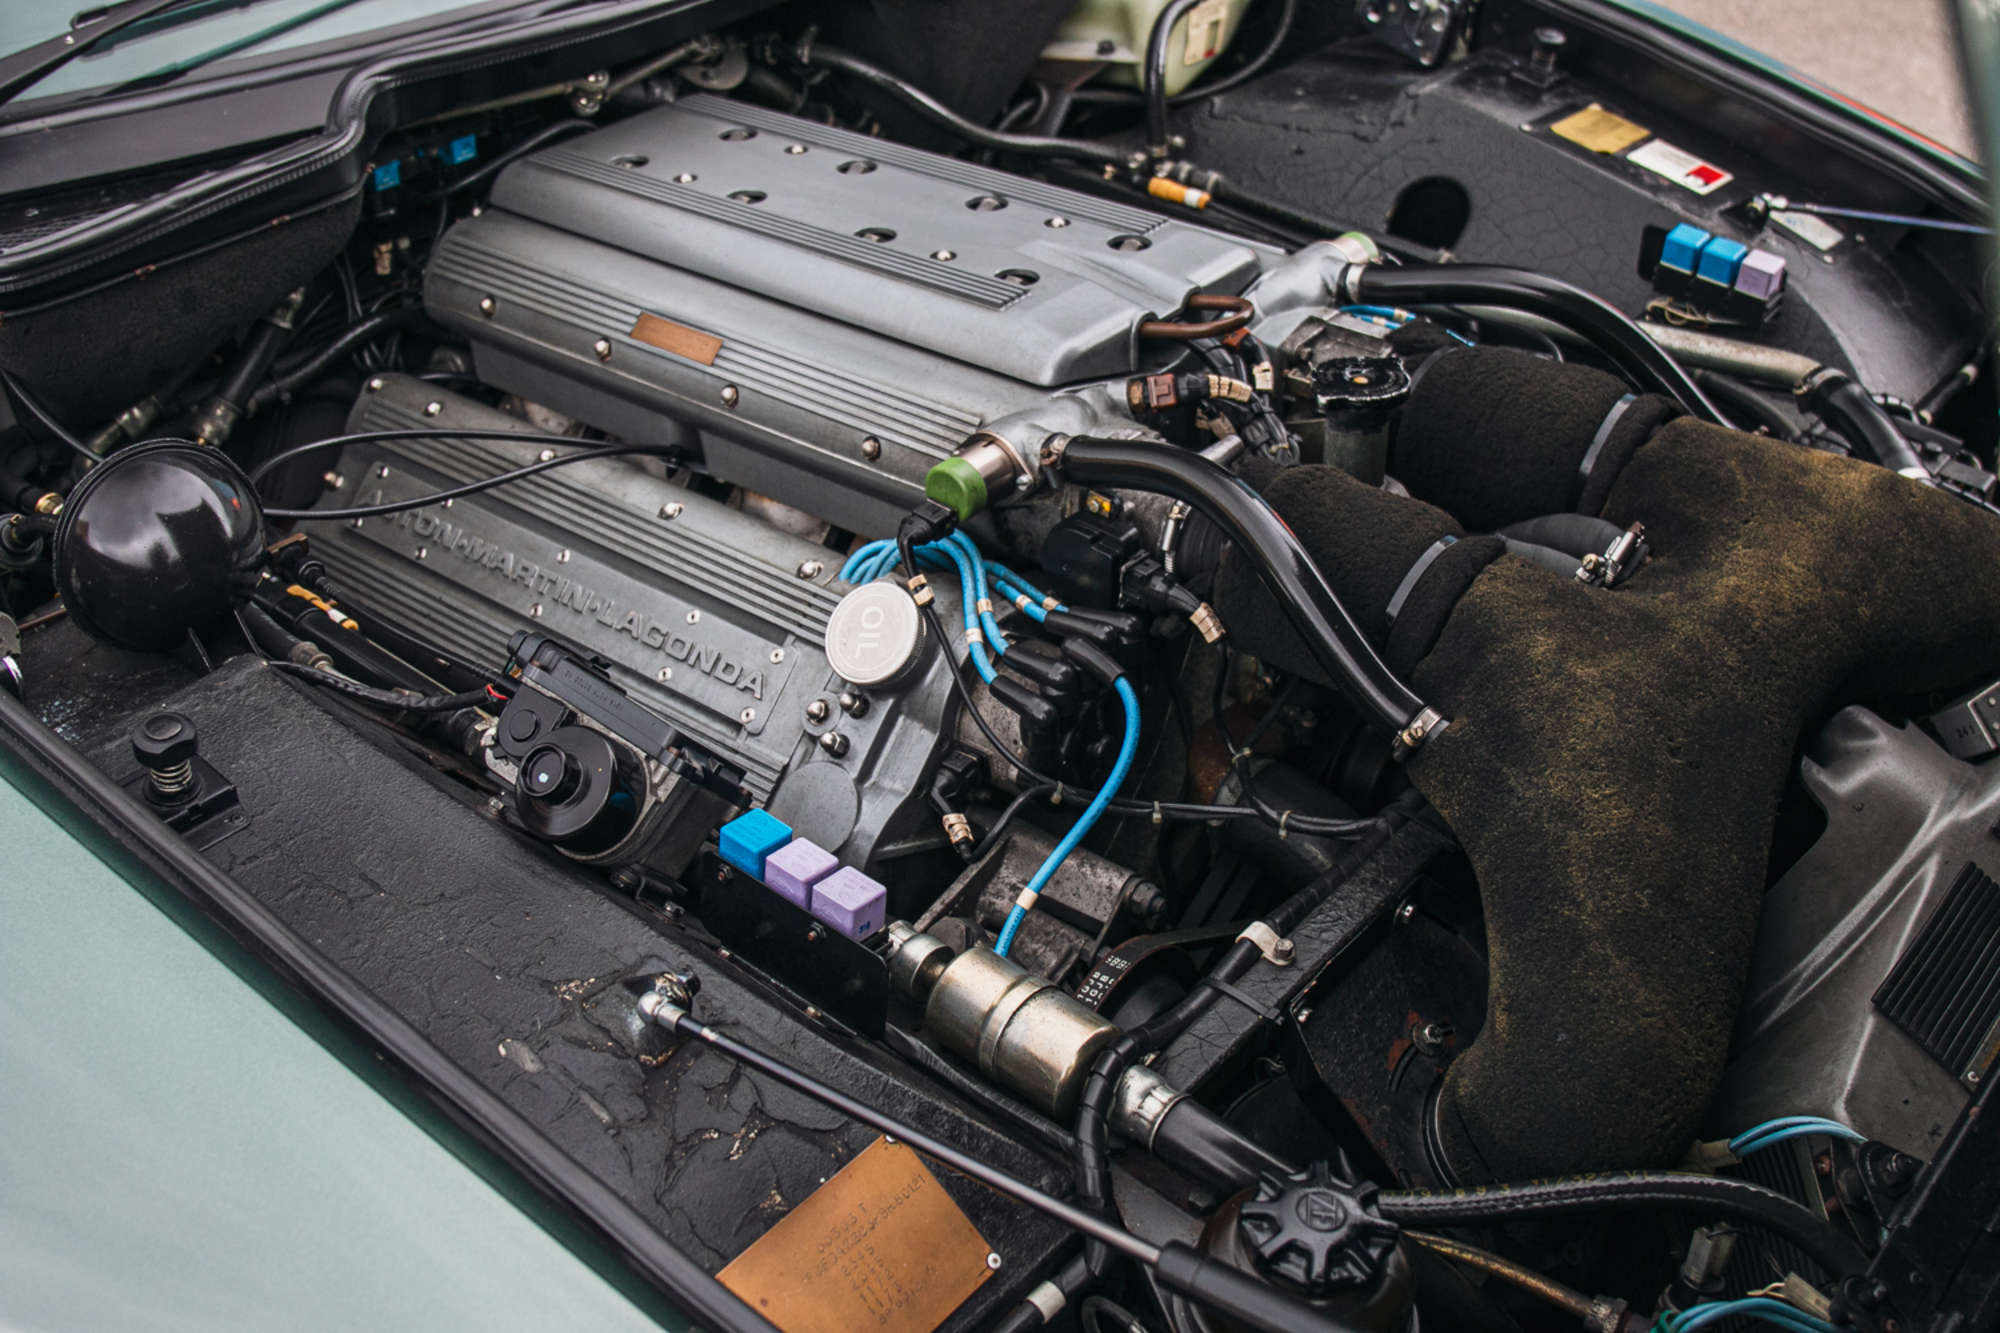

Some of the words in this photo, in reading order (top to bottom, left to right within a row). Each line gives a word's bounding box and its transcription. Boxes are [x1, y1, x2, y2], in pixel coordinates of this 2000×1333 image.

[464, 536, 594, 615] MARTIN
[598, 600, 766, 701] LAGONDA
[854, 606, 884, 659] OIL
